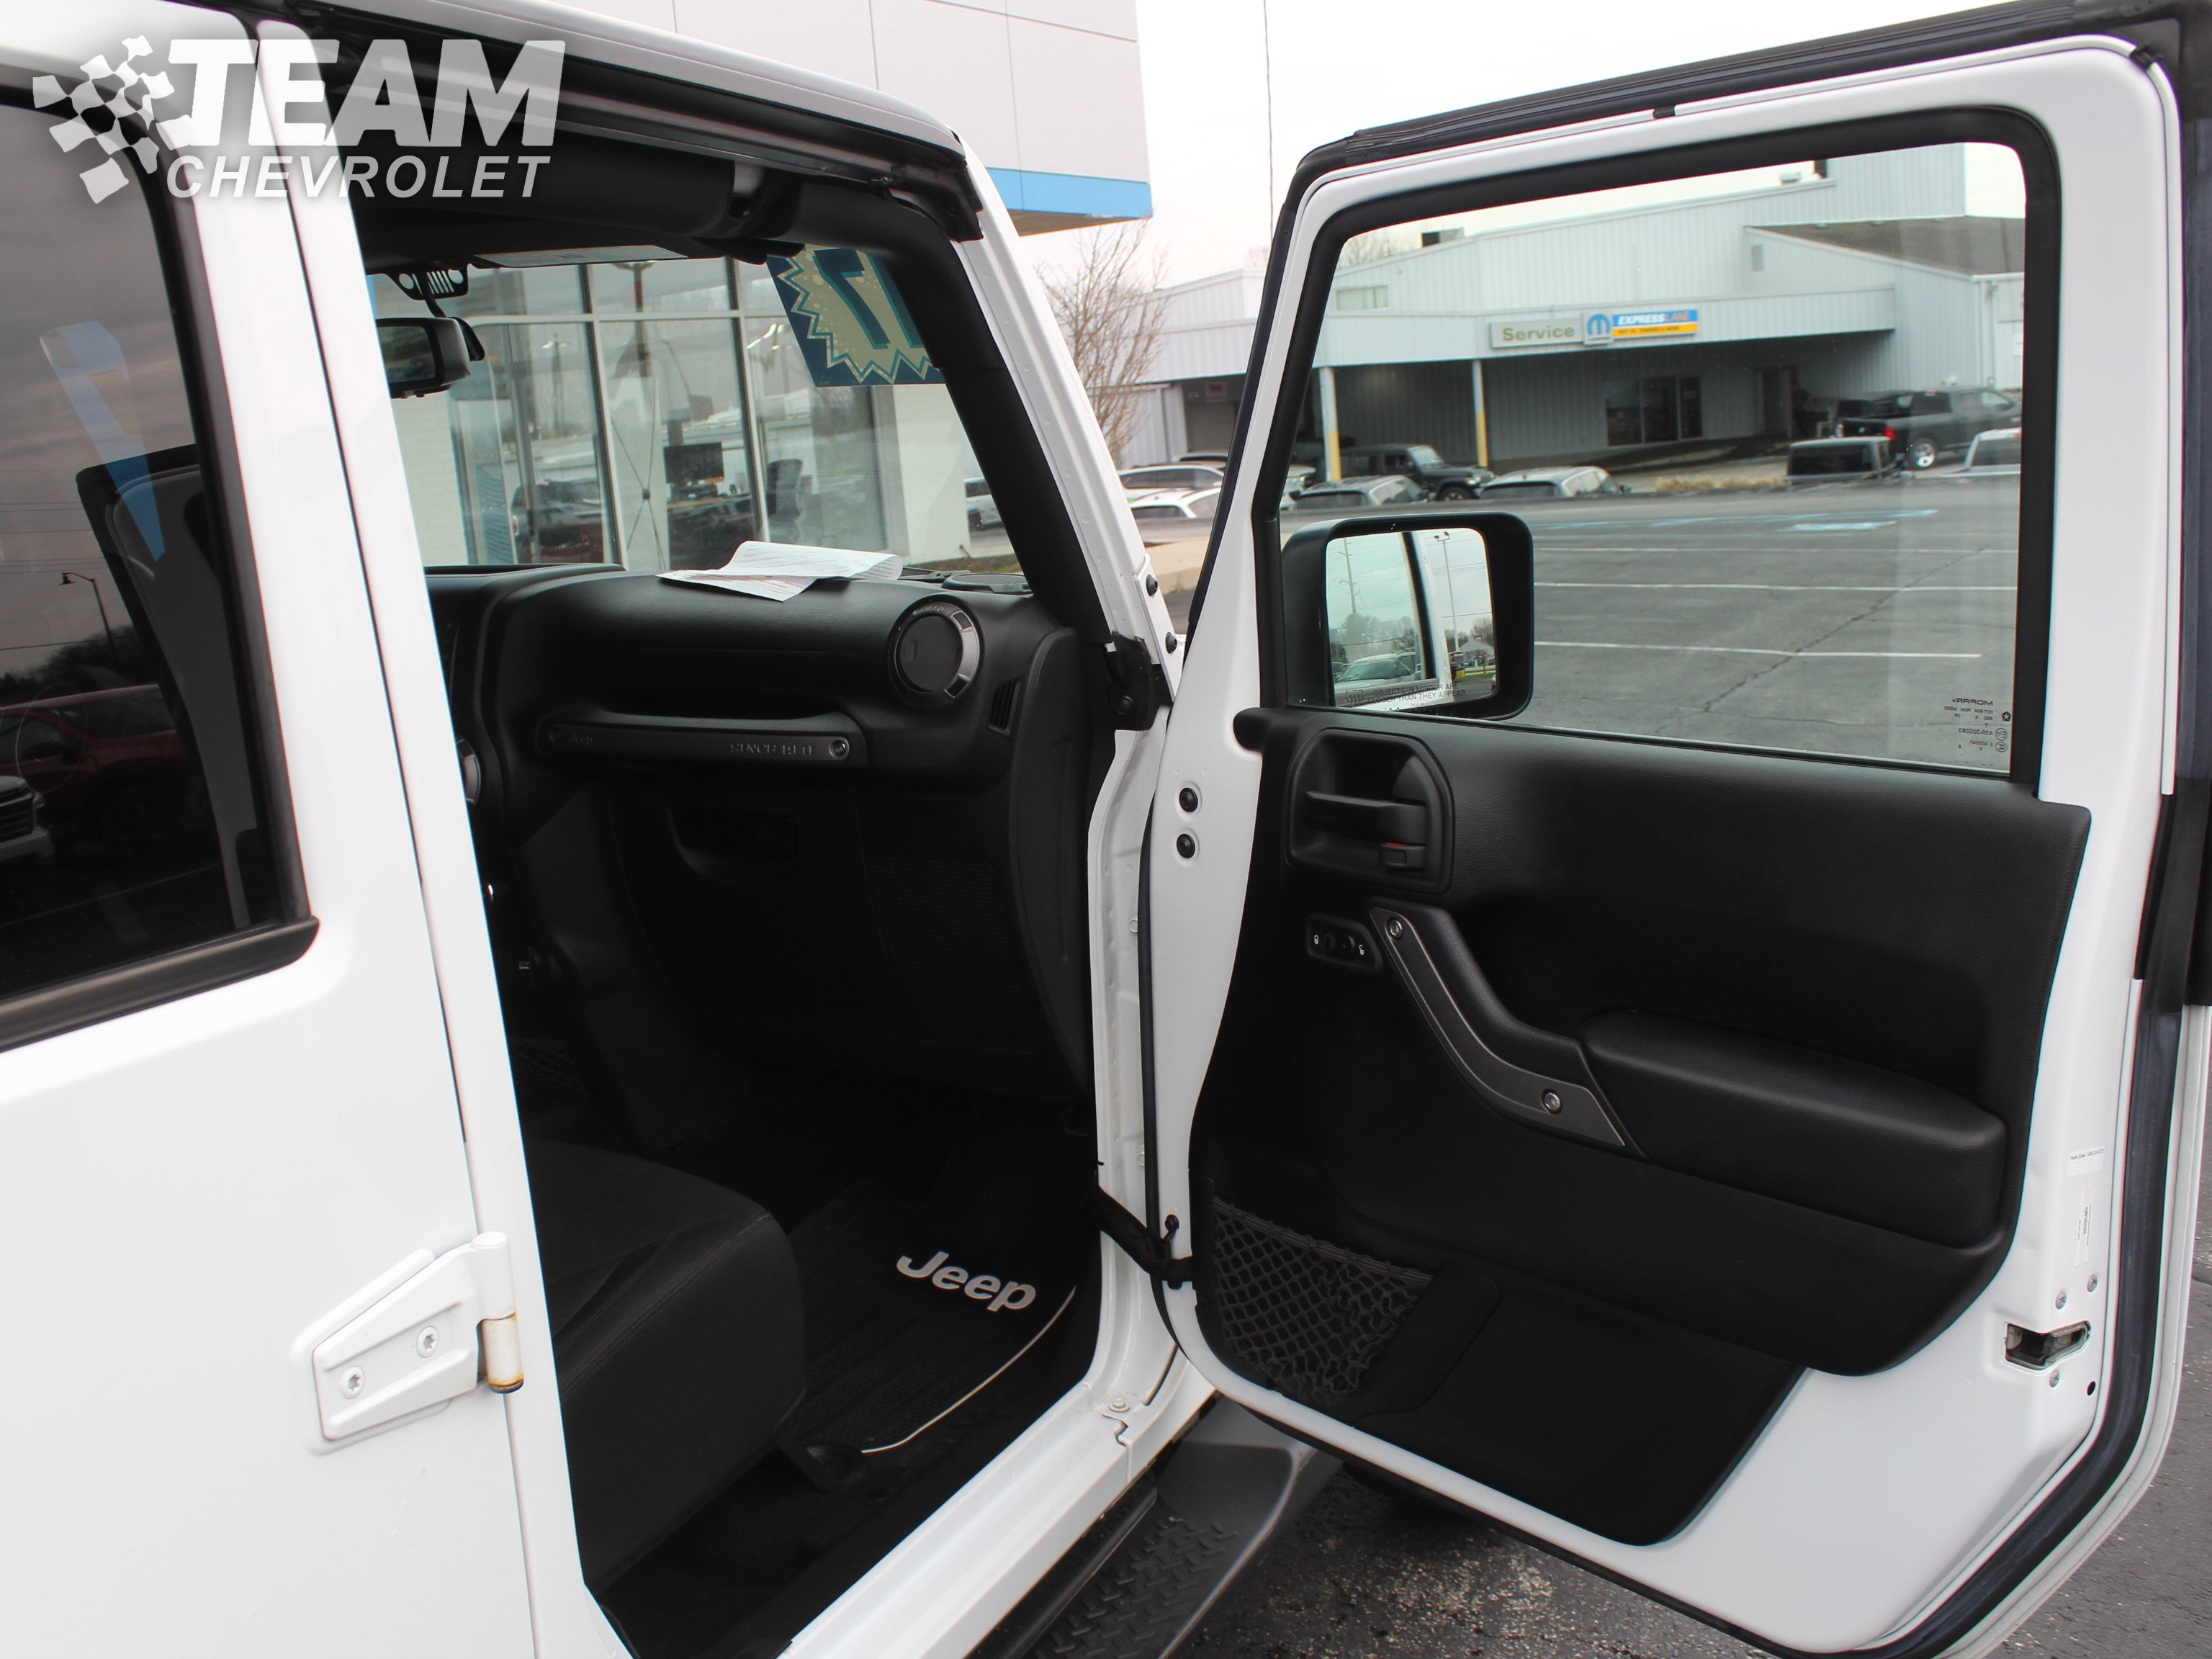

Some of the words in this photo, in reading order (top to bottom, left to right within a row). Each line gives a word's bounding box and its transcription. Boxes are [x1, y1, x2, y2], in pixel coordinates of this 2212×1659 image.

[1502, 325, 1575, 342] Service
[1373, 687, 1406, 696] OBJECTS
[1444, 681, 1458, 690] ARE
[1438, 689, 1466, 698] APPEAR
[730, 742, 777, 754] SINCE
[896, 1251, 1036, 1312] Jeep
